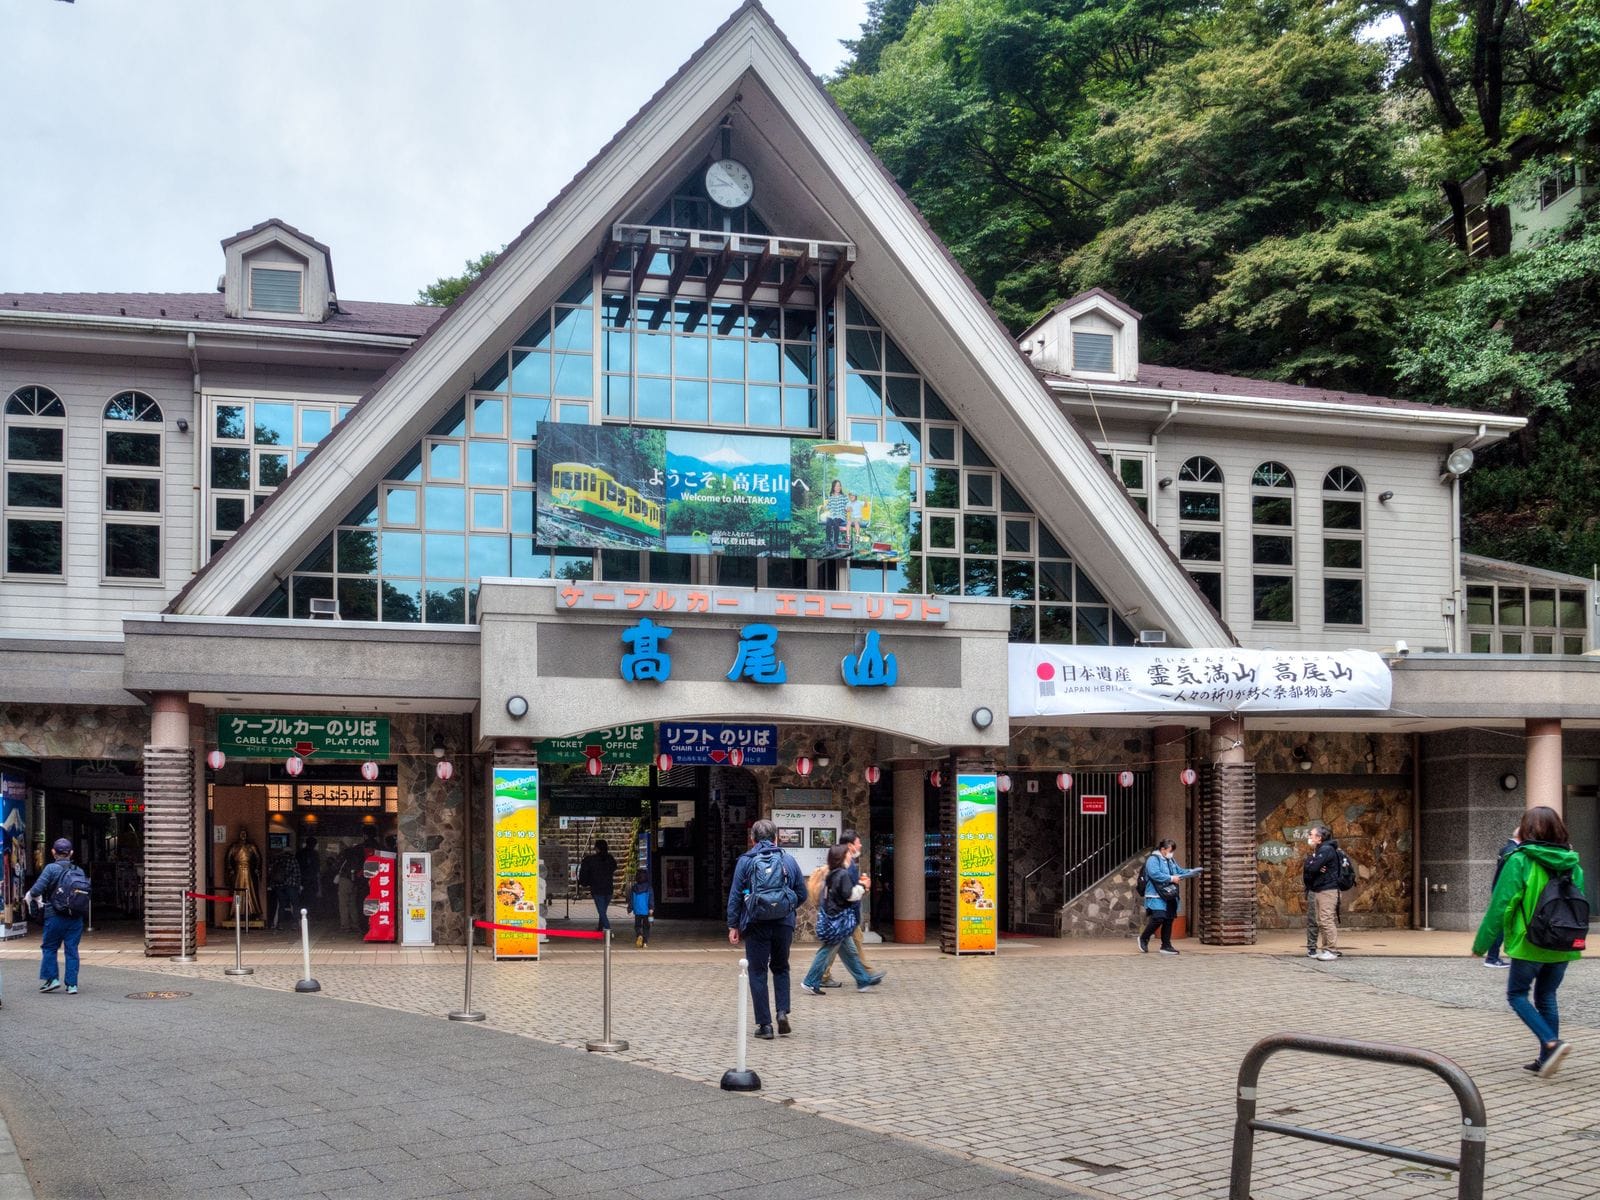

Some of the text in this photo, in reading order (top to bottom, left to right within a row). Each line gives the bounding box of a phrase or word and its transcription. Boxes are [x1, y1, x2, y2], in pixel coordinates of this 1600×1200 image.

[681, 493, 777, 505] Welcome to Mt.TAKAO
[560, 586, 740, 613] ケーブルカー
[1062, 660, 1353, 686] 日本遺産 霊気満山 高尾山
[1063, 685, 1091, 694] JAPAN
[231, 717, 377, 737] ケーブルカーのりば
[235, 736, 380, 746] CABLE CAR PLAT FORM
[666, 727, 770, 746] リフト のりば
[551, 740, 638, 750] TICKET OFFICE
[303, 788, 375, 802] きっぷうりば
